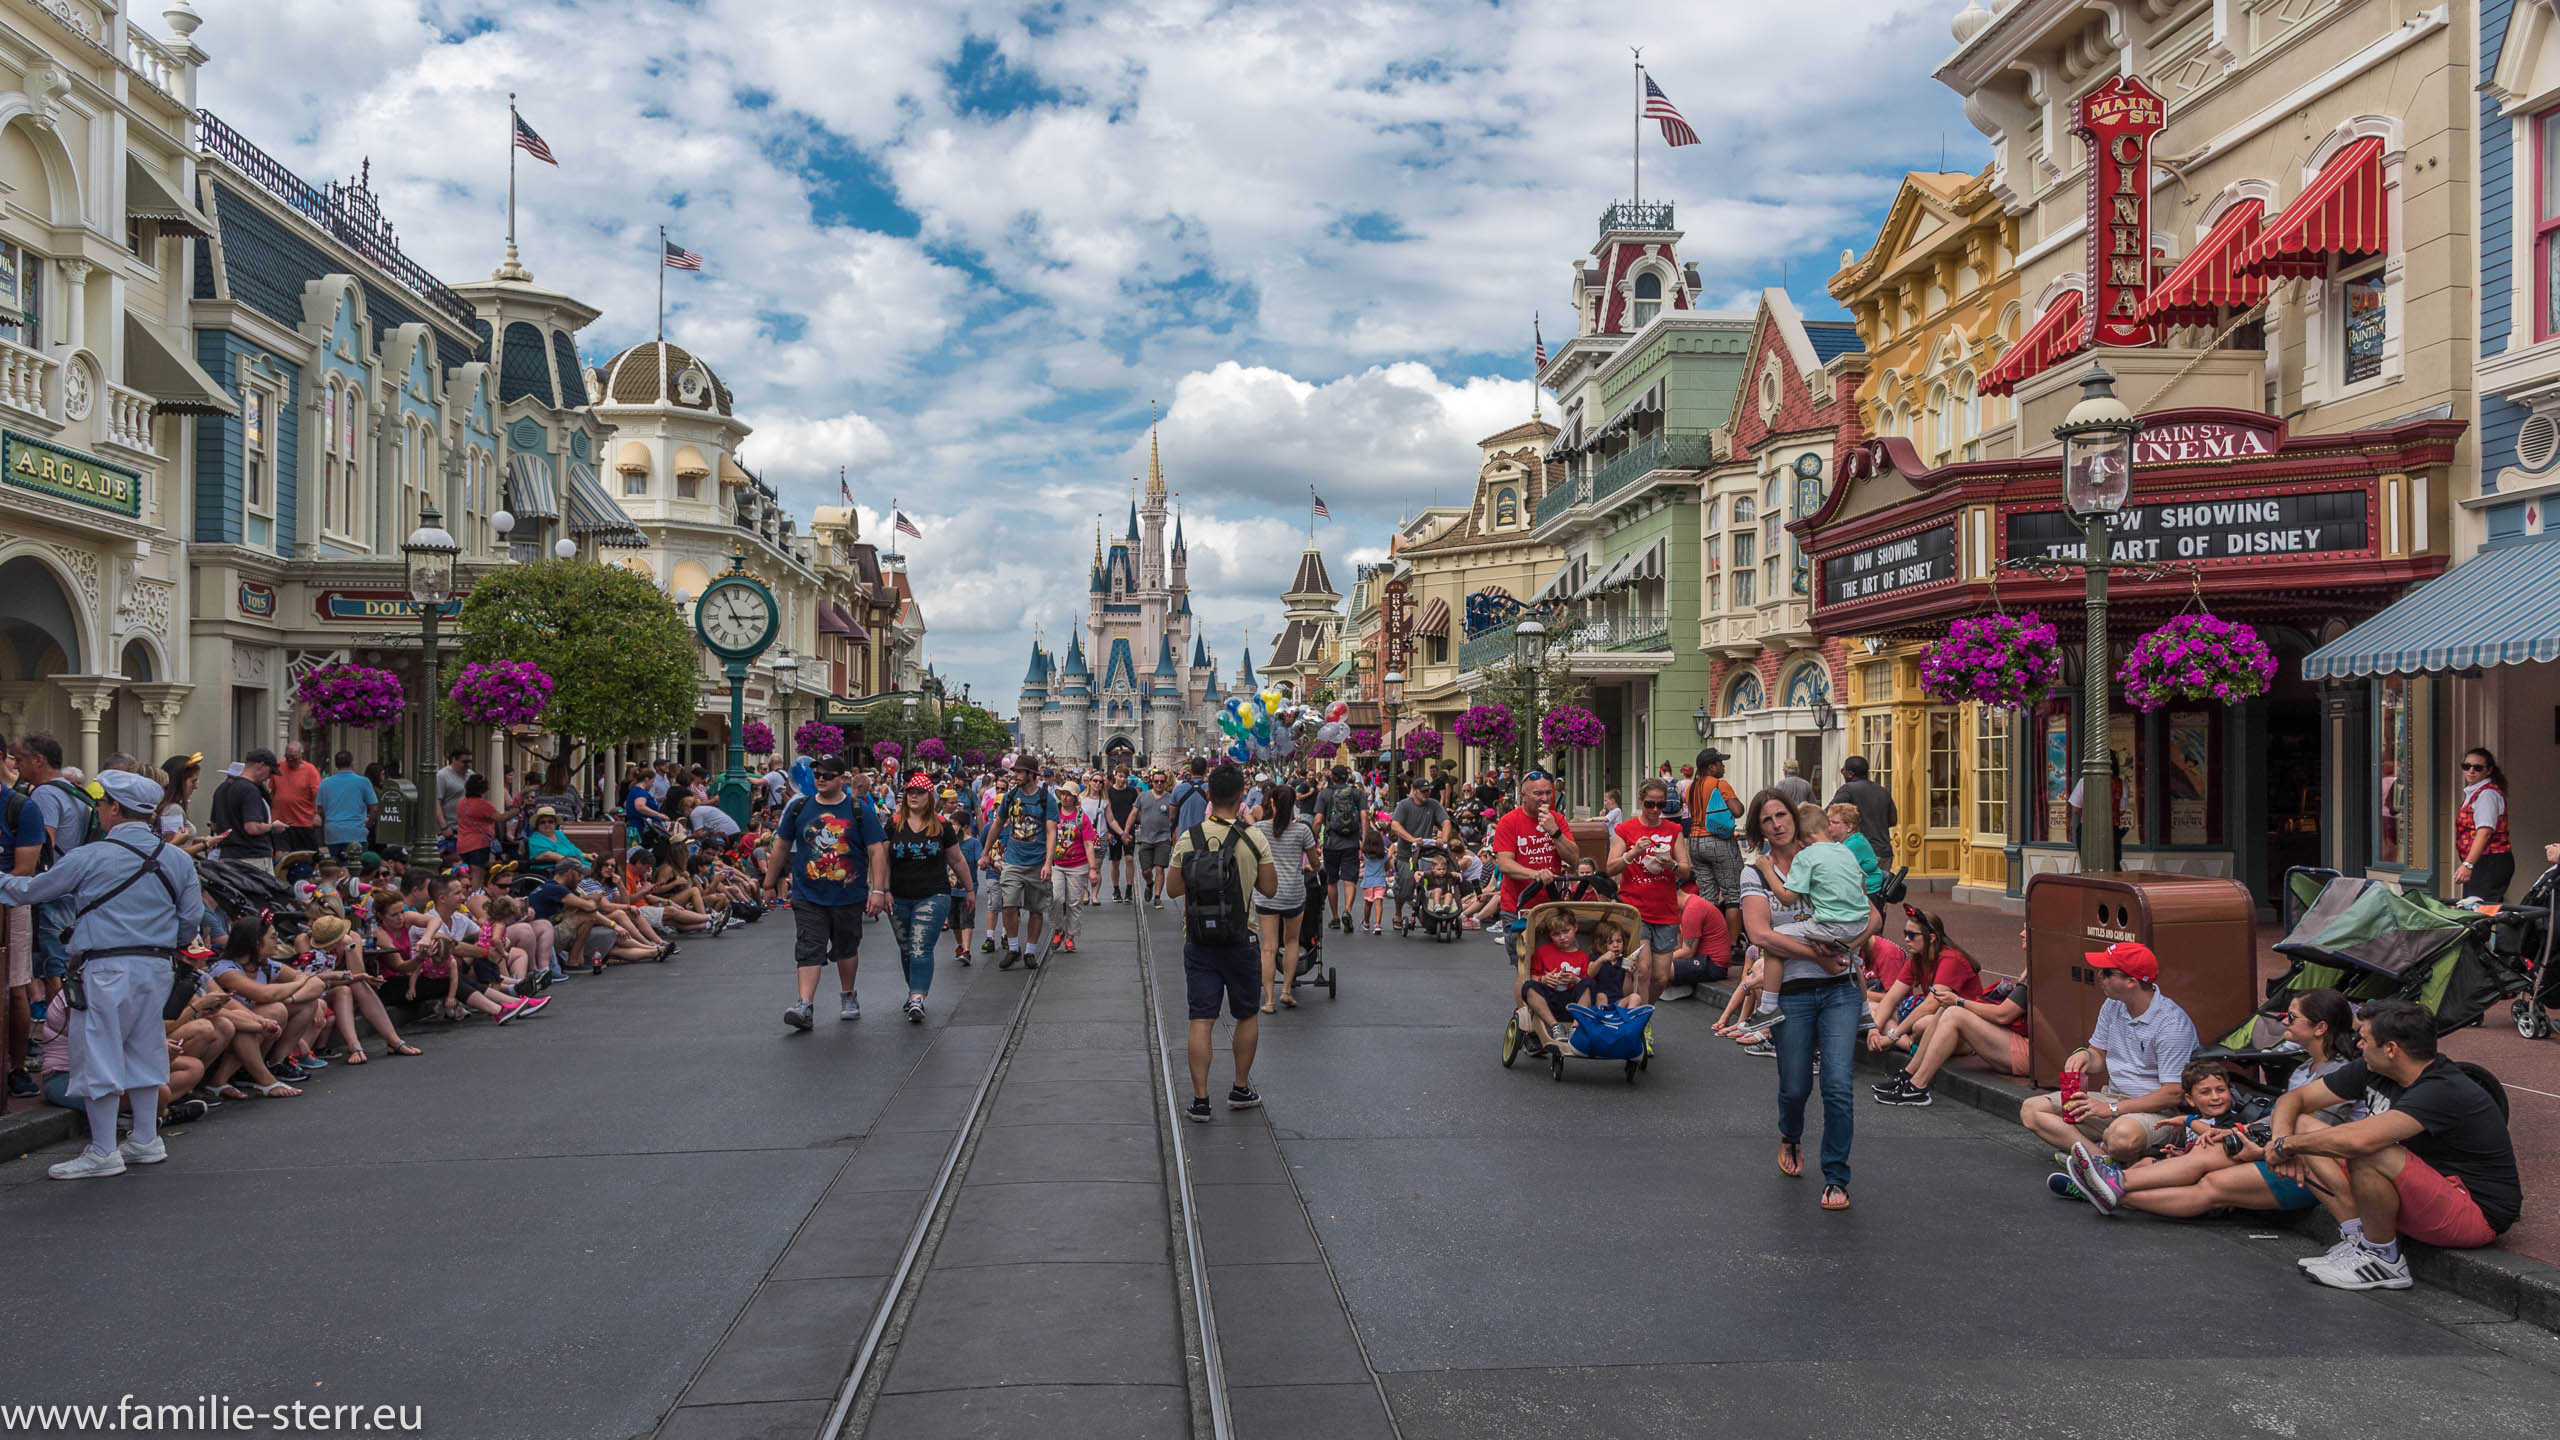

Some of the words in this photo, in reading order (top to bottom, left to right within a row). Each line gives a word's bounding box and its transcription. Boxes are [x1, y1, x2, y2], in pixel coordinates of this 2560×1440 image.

[2091, 97, 2154, 120] MAIN
[2129, 109, 2160, 124] ST.
[2105, 133, 2146, 317] CINEMA
[2133, 431, 2268, 463] INEMA
[2139, 425, 2195, 442] MAIN
[2200, 424, 2227, 438] ST.
[15, 451, 127, 502] ARCADE
[2086, 509, 2142, 536] OW
[2160, 501, 2280, 529] SHOWING
[1853, 552, 1873, 572] NOW
[1877, 539, 1918, 566] SHOWING
[2111, 538, 2160, 561] ART
[2177, 536, 2210, 556] OF
[2227, 529, 2321, 554] DISNEY
[1842, 581, 1858, 599] THE
[1862, 575, 1879, 595] ART
[1883, 571, 1895, 589] OF
[1899, 561, 1933, 586] DISNEY
[247, 596, 266, 609] TOYS
[1528, 833, 1553, 845] Famil
[2087, 926, 2105, 938] BOTTLES
[2105, 930, 2114, 939] AND
[2114, 931, 2125, 941] CANS
